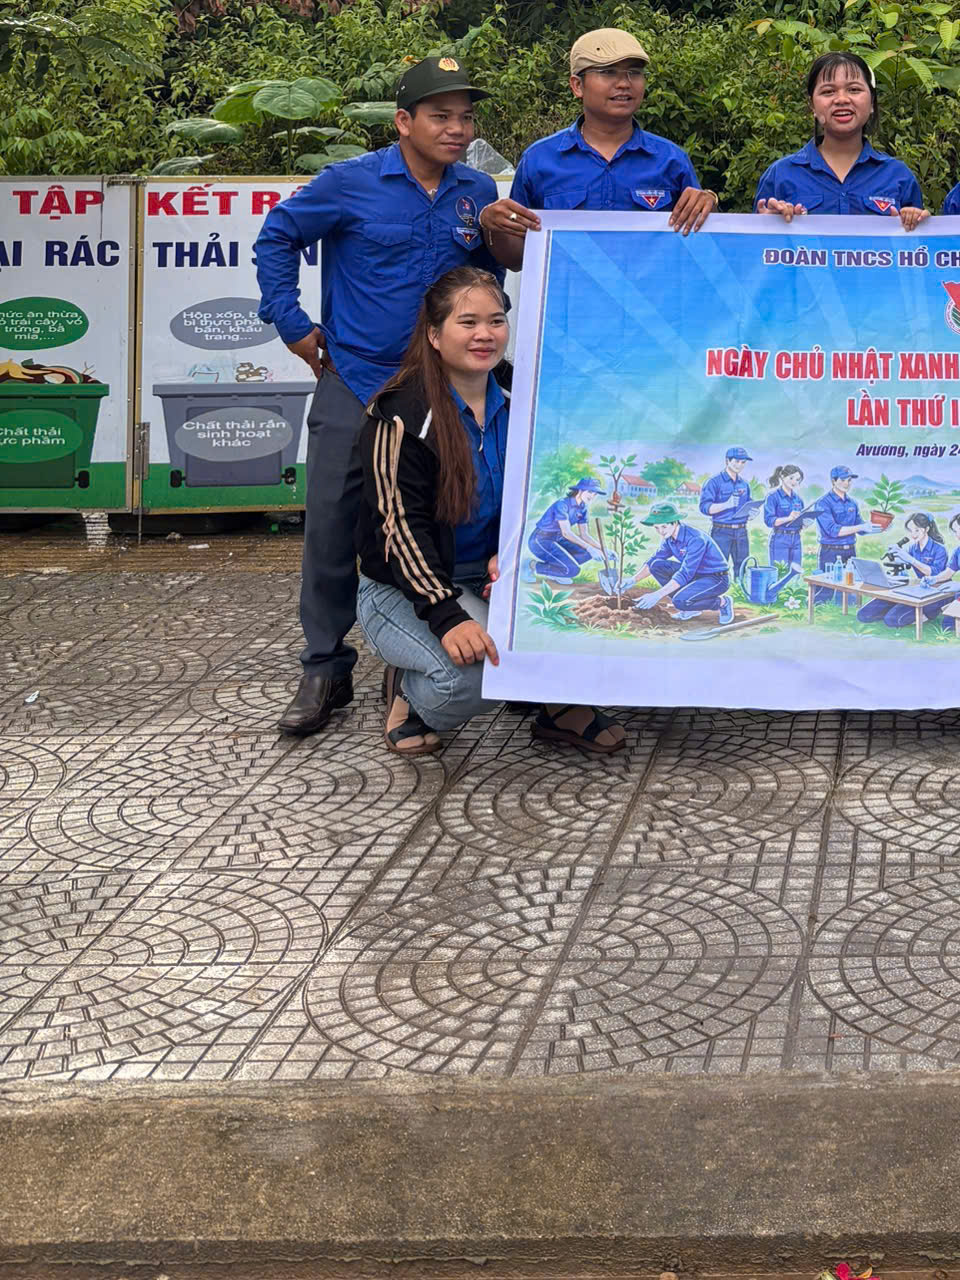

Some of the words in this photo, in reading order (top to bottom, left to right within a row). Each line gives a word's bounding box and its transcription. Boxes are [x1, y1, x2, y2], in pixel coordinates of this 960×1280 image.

[12, 185, 105, 220] TẬP
[148, 183, 239, 216] KẾT
[45, 235, 120, 267] RÁC
[152, 232, 239, 267] THẢI
[764, 246, 827, 266] ĐOÀN
[832, 250, 893, 267] TNCS
[898, 246, 929, 267] HỒ
[183, 311, 212, 320] Hộp
[707, 344, 769, 379] NGÀY
[775, 345, 825, 380] CHỦ
[832, 347, 894, 385] NHẬT
[899, 351, 960, 380] XANH
[847, 388, 890, 427] LẦN
[896, 393, 946, 427] THỨ
[182, 420, 221, 430] Chất
[225, 419, 255, 429] thải
[197, 429, 230, 438] sinh
[236, 429, 271, 439] hoạt
[212, 438, 251, 447] khác
[856, 443, 909, 458] Avương,
[913, 442, 946, 458] ngày
